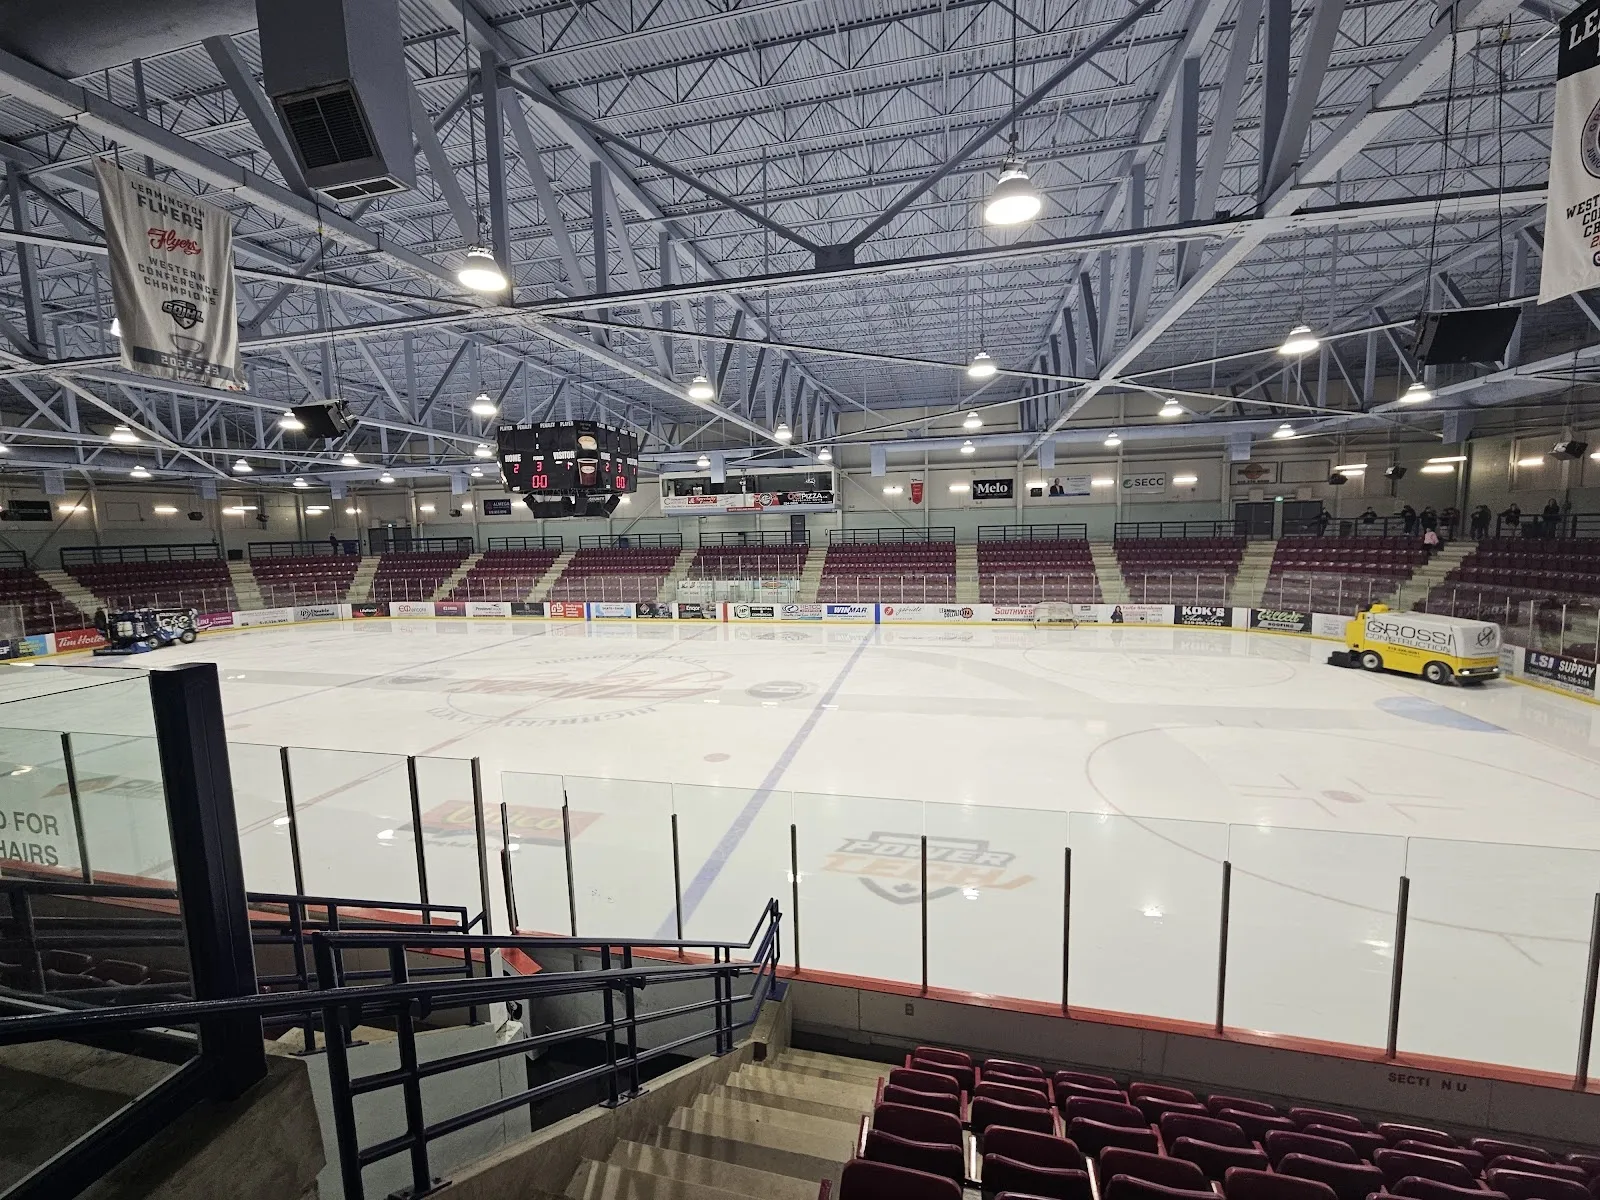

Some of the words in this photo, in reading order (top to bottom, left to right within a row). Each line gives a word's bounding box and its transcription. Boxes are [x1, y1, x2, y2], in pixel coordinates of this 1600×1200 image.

[131, 181, 205, 218] LEAMINGTON
[137, 194, 203, 231] FLYERS
[147, 228, 202, 256] Flyers
[138, 263, 219, 297] CONFERENCE
[149, 256, 205, 283] WESTERN
[144, 275, 217, 305] CHAMPIONS
[163, 302, 204, 323] GOJHL
[160, 355, 219, 375] 2022-23
[505, 454, 522, 463] HOME
[553, 450, 575, 460] VISITOR
[513, 463, 520, 474] 2
[536, 461, 543, 472] 3
[617, 463, 622, 473] 3
[977, 483, 1008, 494] Melo
[1134, 477, 1164, 488] SECC
[1182, 606, 1225, 617] KOK'S
[57, 636, 76, 648] Tim
[1365, 632, 1451, 653] CONSTRUCTION
[1366, 620, 1451, 646] GROSSI
[1530, 652, 1555, 669] LSI
[1559, 660, 1595, 678] SUPPLY
[13, 811, 59, 836] FOR
